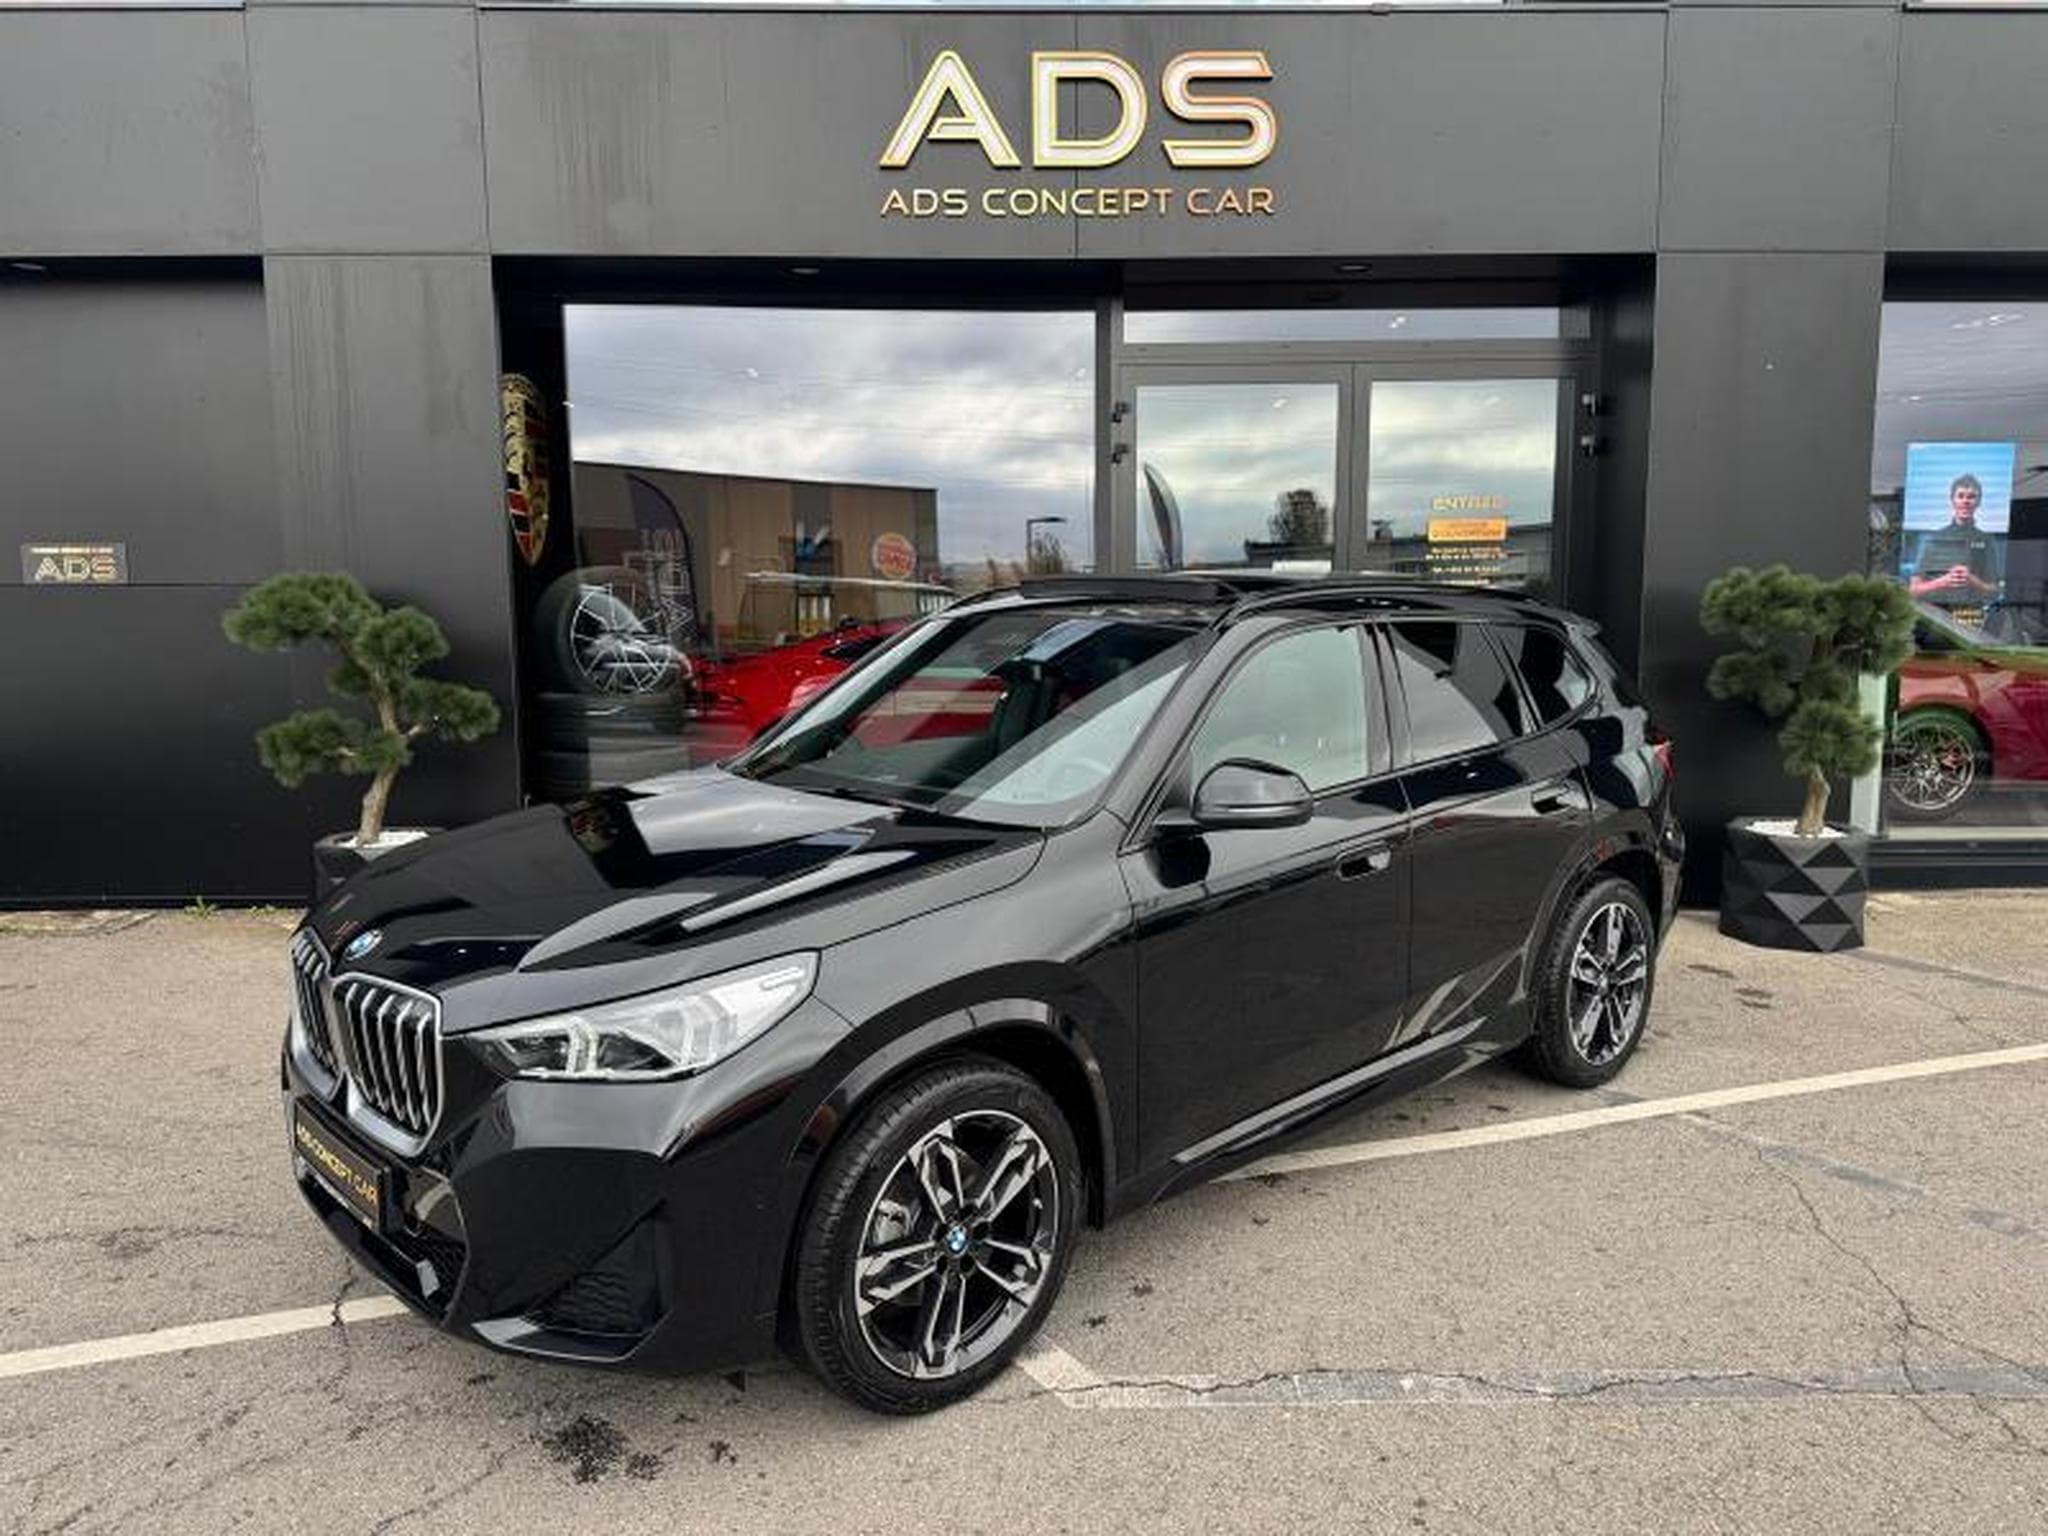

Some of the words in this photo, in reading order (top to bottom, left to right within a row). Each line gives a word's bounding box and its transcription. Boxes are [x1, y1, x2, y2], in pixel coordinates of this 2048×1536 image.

[880, 50, 1278, 168] ADS
[881, 189, 969, 216] ADS
[983, 188, 1173, 216] CONCEPT
[1187, 188, 1275, 216] CAR
[34, 555, 117, 581] ADS
[353, 1173, 378, 1205] CAR
